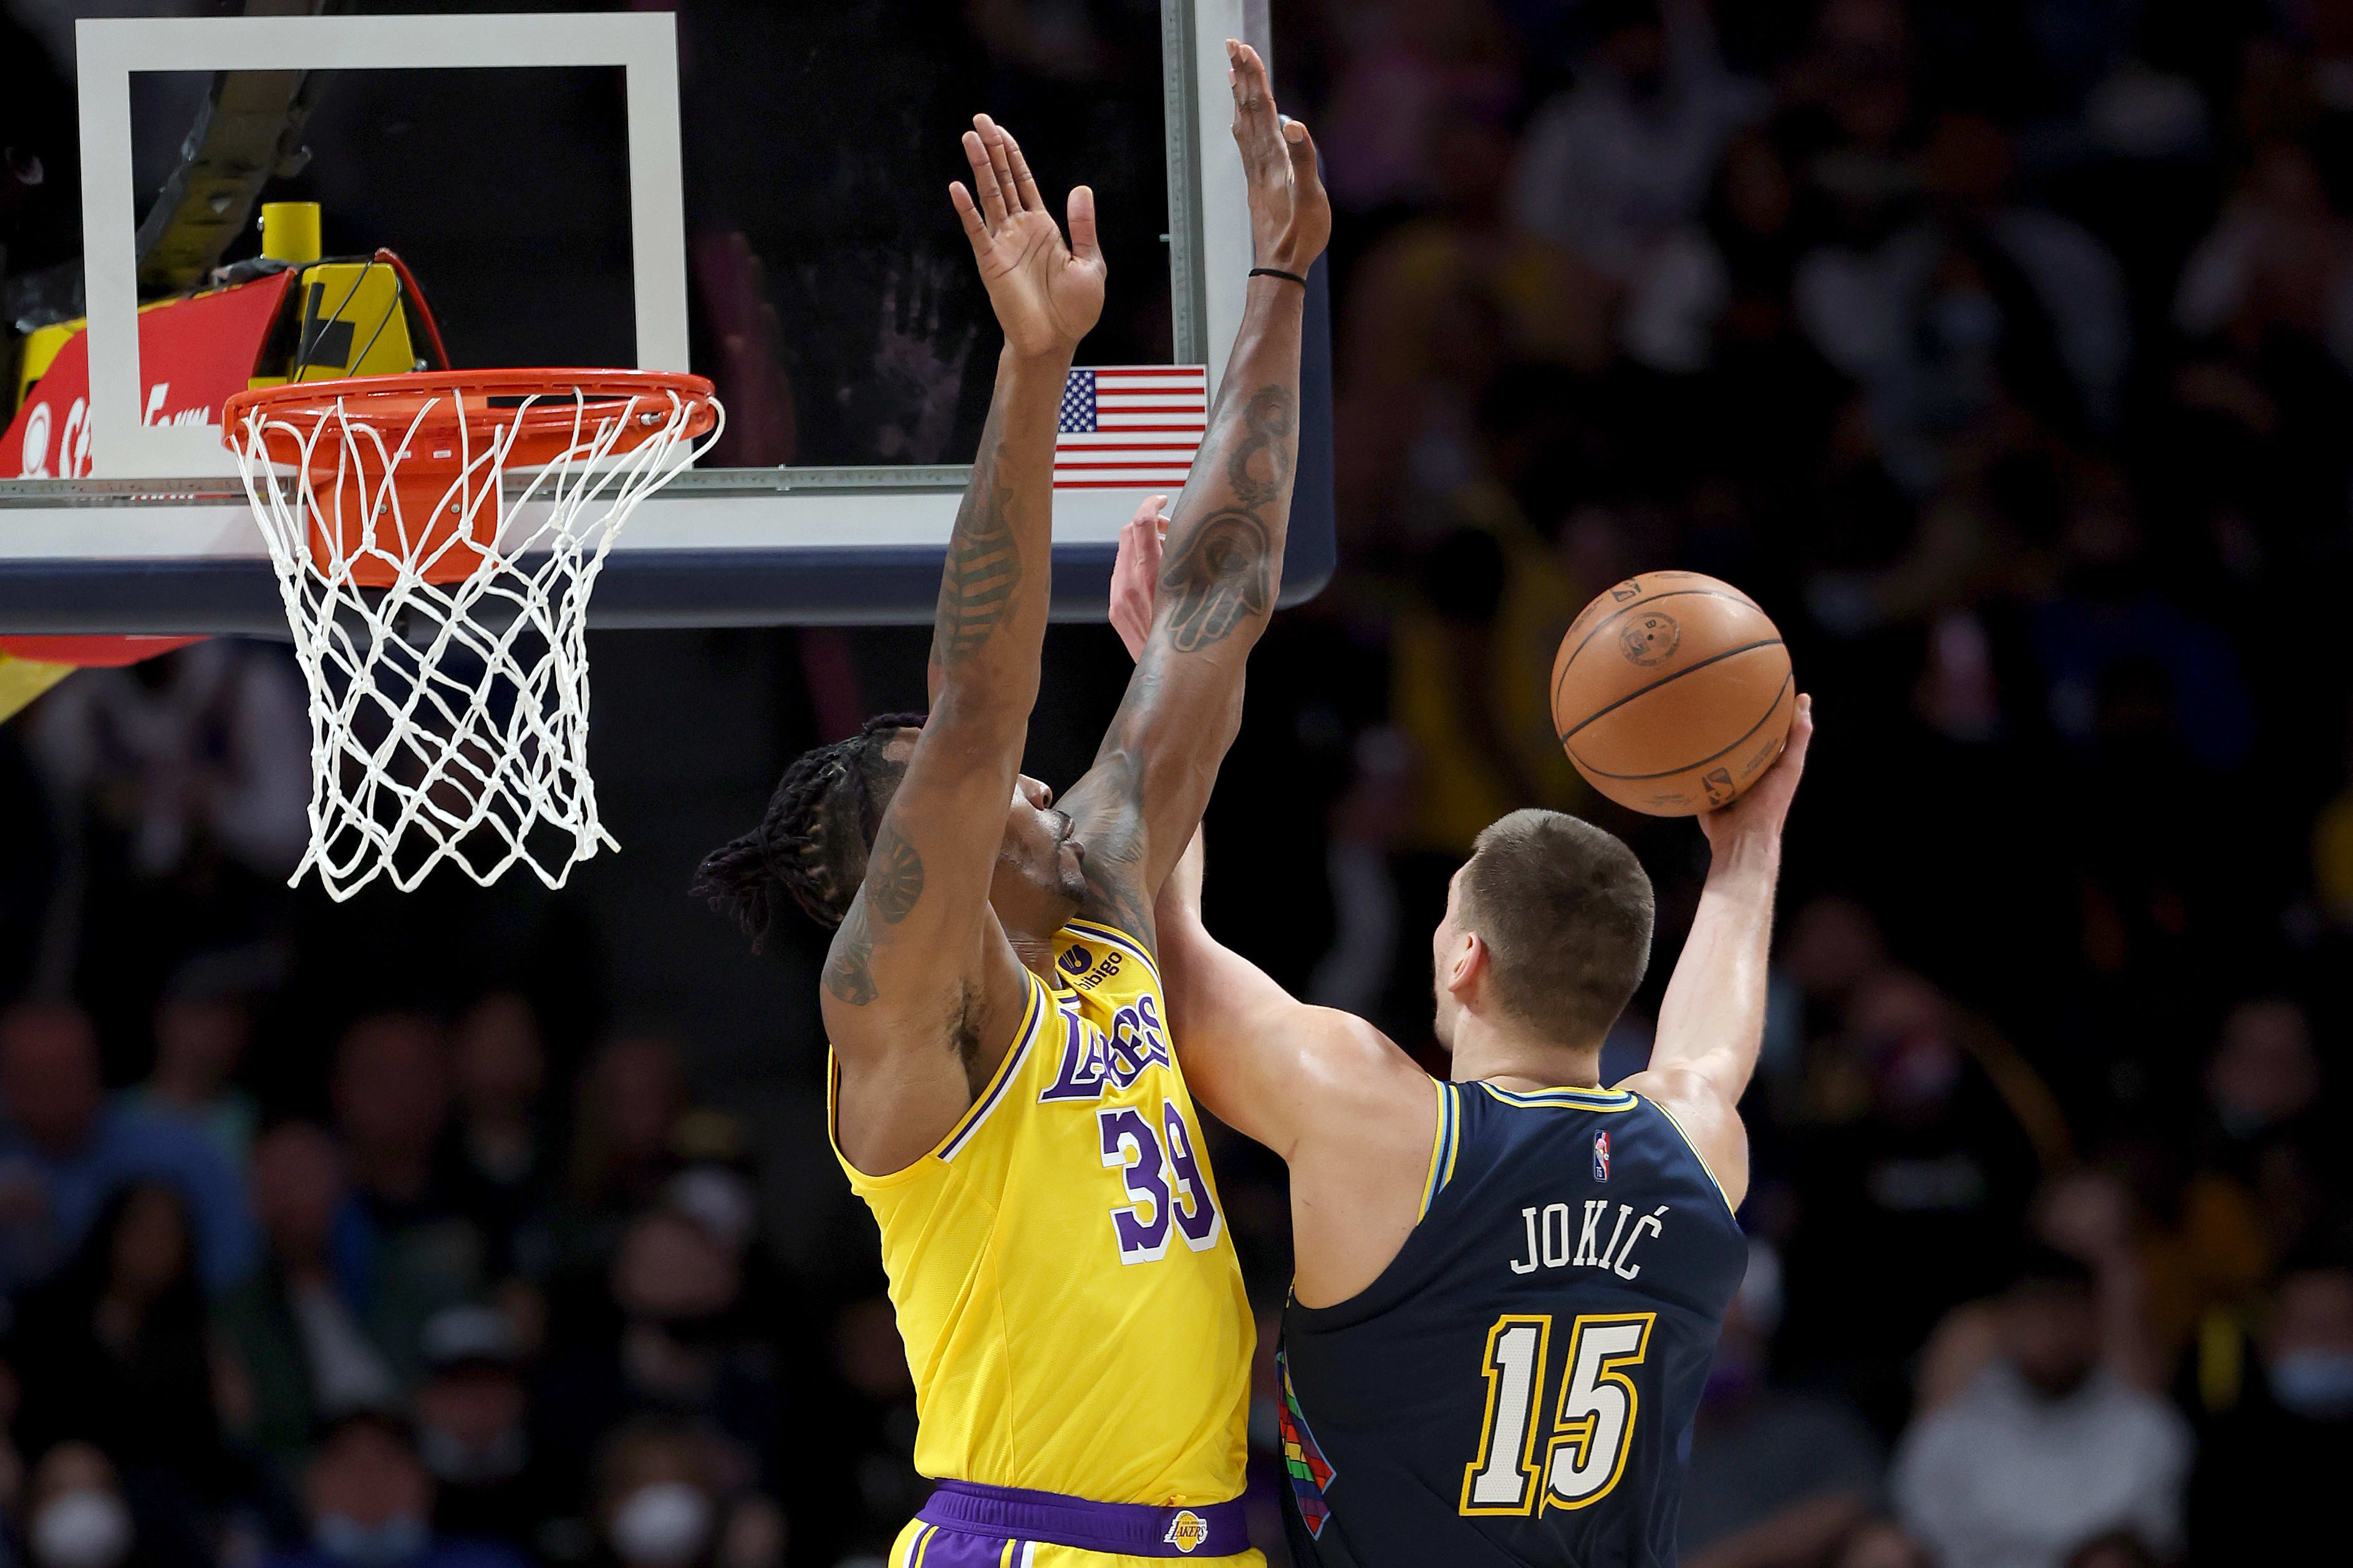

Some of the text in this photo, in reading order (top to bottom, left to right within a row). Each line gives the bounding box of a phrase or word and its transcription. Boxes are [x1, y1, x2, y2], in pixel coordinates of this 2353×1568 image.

[1073, 952, 1122, 990] bibigo
[1096, 1097, 1222, 1265] 39
[1510, 1200, 1669, 1280] JOKIĆ
[1459, 1312, 1657, 1519] 15
[1165, 1521, 1206, 1542] LAKERS
